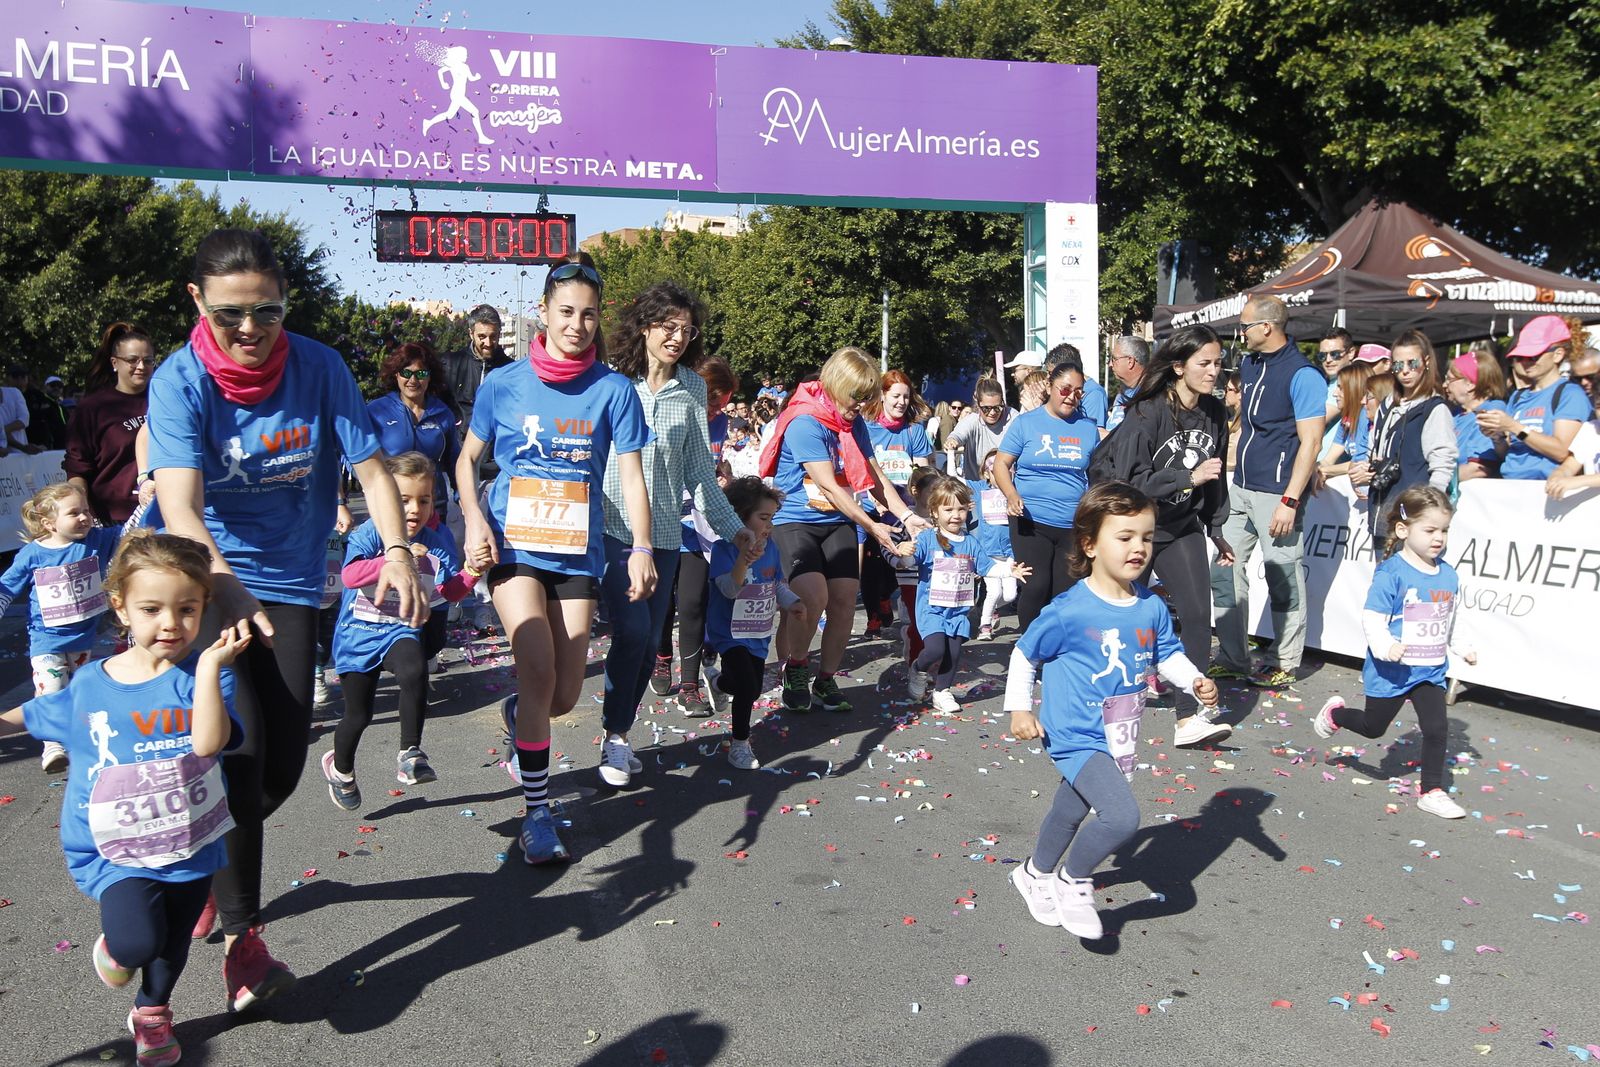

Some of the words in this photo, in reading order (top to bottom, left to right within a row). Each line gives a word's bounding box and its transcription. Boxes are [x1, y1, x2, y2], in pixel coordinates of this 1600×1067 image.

[0, 37, 190, 91] MERÍA
[490, 49, 557, 79] VIII
[490, 83, 560, 97] CARRERA
[269, 145, 302, 164] LA
[312, 146, 451, 170] IGUALDAD
[461, 153, 491, 172] ES
[500, 155, 618, 177] NUESTRA
[625, 160, 704, 181] META.
[1061, 240, 1083, 249] NEXA
[1061, 255, 1081, 266] CDX
[554, 417, 593, 436] VIII
[260, 424, 310, 454] VIII
[551, 436, 592, 446] CARRERA
[261, 450, 315, 467] CARRERA
[879, 459, 906, 475] 2163
[530, 500, 570, 520] 177
[49, 576, 92, 600] 3157
[942, 572, 971, 586] 3156
[114, 779, 209, 828] 3106
[143, 820, 166, 831] EVA
